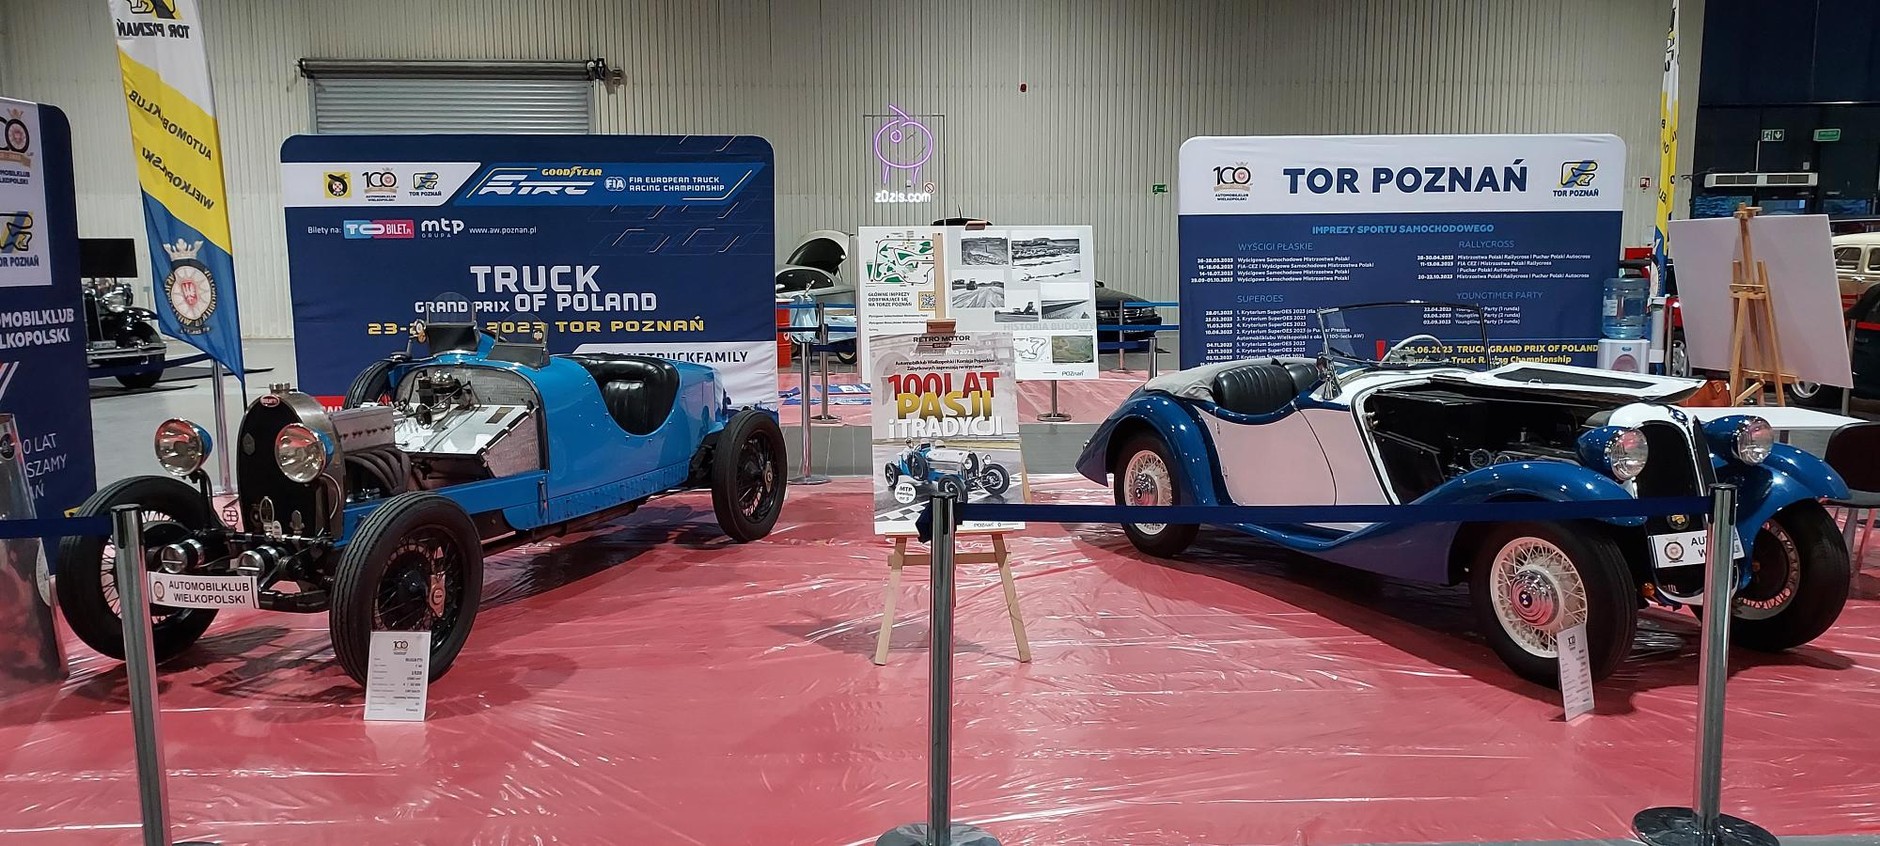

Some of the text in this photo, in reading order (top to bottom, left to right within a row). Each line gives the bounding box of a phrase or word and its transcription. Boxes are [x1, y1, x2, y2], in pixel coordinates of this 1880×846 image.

[541, 165, 603, 178] GOODYEAR
[1283, 159, 1528, 195] TOR POZNAŃ
[629, 176, 720, 184] FIA EUROPEAN TRUCK
[663, 184, 725, 192] CHAMPIONSHIP
[1569, 189, 1599, 197] POZNAŃ
[307, 226, 342, 235] Bilety na:
[421, 218, 464, 235] mtp
[469, 226, 537, 236] www.aw.poznan.pl
[1312, 224, 1495, 235] IMPREZY SPORTU SAMOCHODOWEGO
[1238, 242, 1313, 251] WYŚCIGI PŁASKIE
[1458, 240, 1515, 249] RALLYCROSS
[10, 255, 40, 268] POZNAŃ
[469, 265, 601, 293] TRUCK
[1237, 294, 1284, 303] SUPEROES
[1456, 291, 1543, 300] YOUNGTIMER PARTY
[414, 292, 657, 313] GRAND PRIX OF POLAND
[555, 321, 601, 333] TOR
[611, 315, 705, 333] POZNAŃ
[1003, 321, 1095, 331] HISTORIA BUDOWY
[1490, 345, 1522, 353] GRAND
[1523, 344, 1546, 352] PRIX
[1547, 344, 1560, 352] OF
[1561, 344, 1599, 352] POLAND
[1451, 355, 1572, 365] Truck Championship
[887, 371, 1000, 401] 100 LAT
[896, 389, 993, 422] PASJI
[888, 415, 1003, 439] i TRADYCJI
[26, 453, 68, 478] SZAMY
[168, 580, 250, 592] AUTOMOBILKLUB
[173, 593, 246, 604] WIELKOPOLSKI
